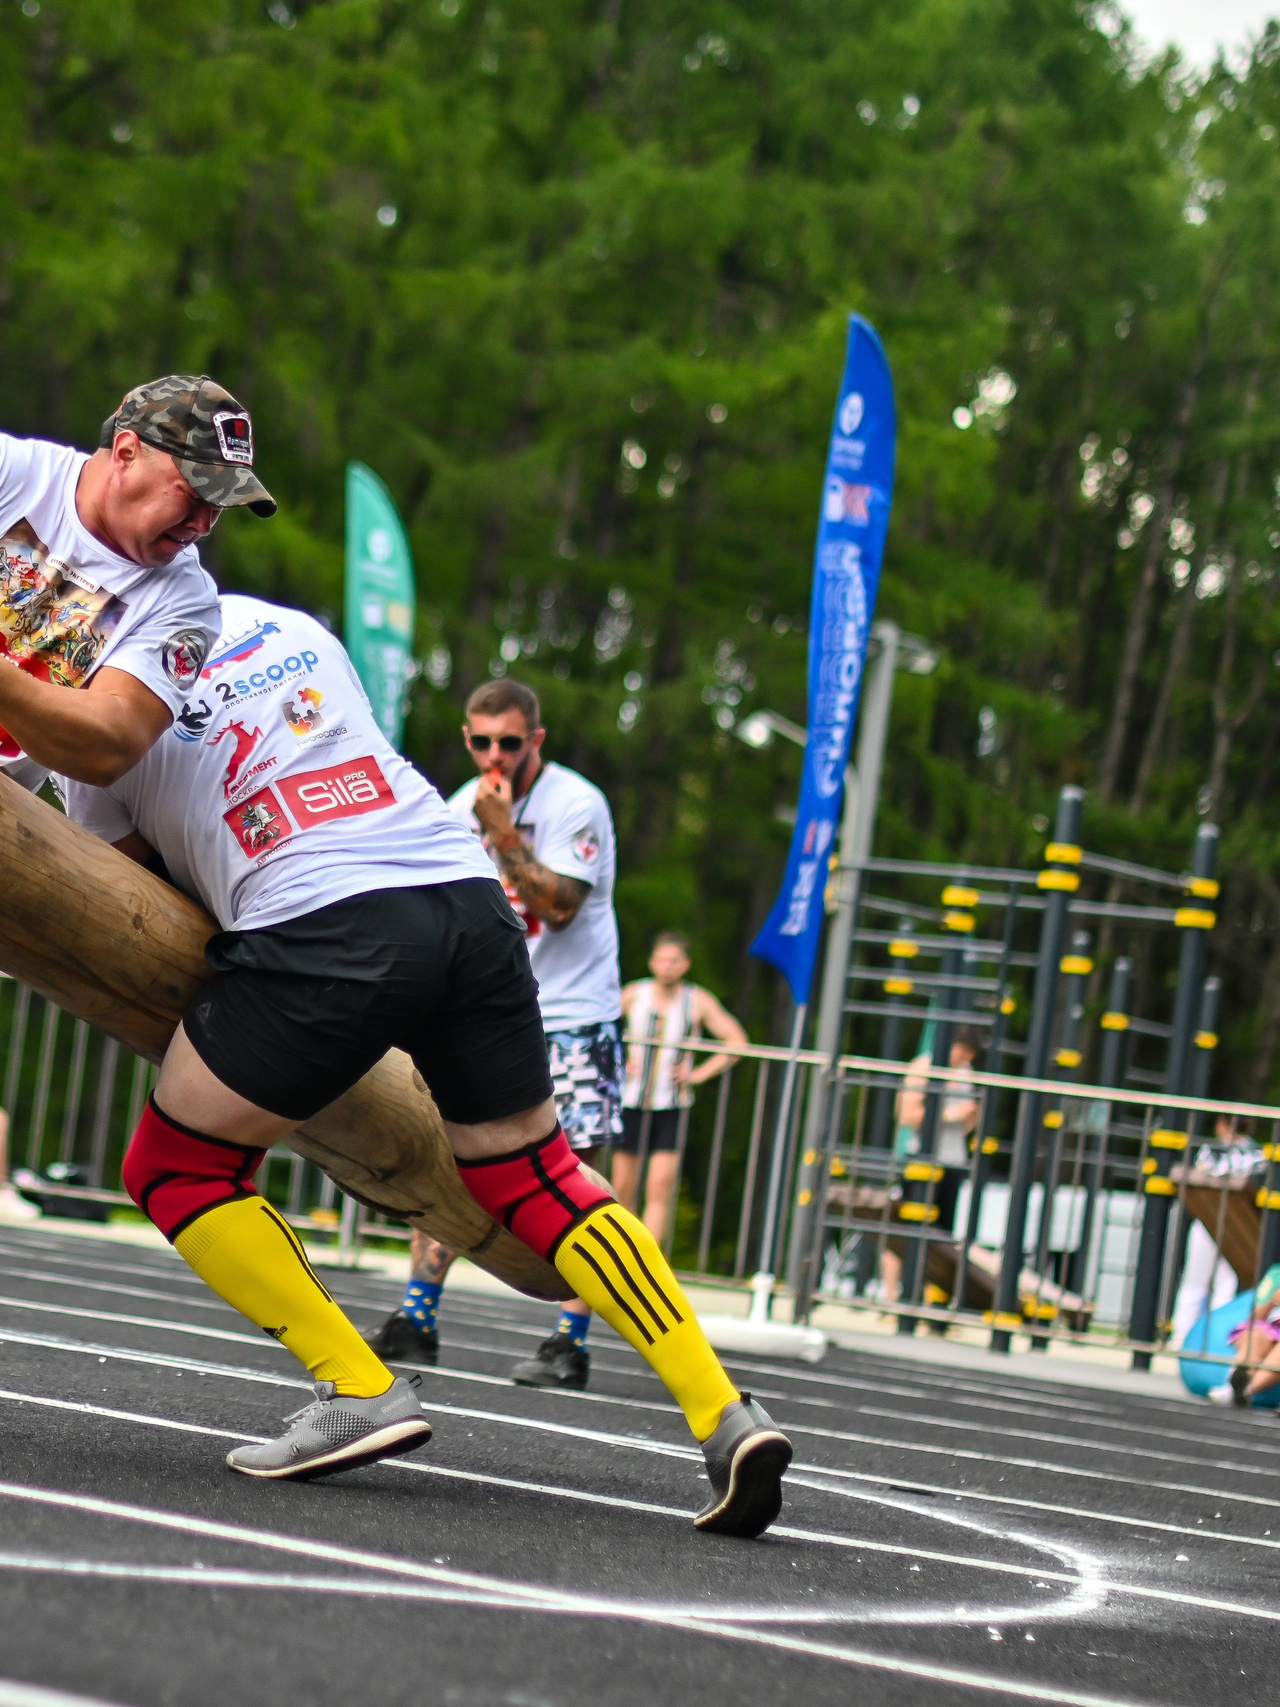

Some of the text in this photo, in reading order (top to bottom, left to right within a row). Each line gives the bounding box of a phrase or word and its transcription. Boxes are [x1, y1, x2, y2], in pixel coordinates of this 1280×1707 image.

[215, 651, 319, 703] 2scoop
[297, 777, 380, 813] Sila
[344, 771, 367, 784] PRO
